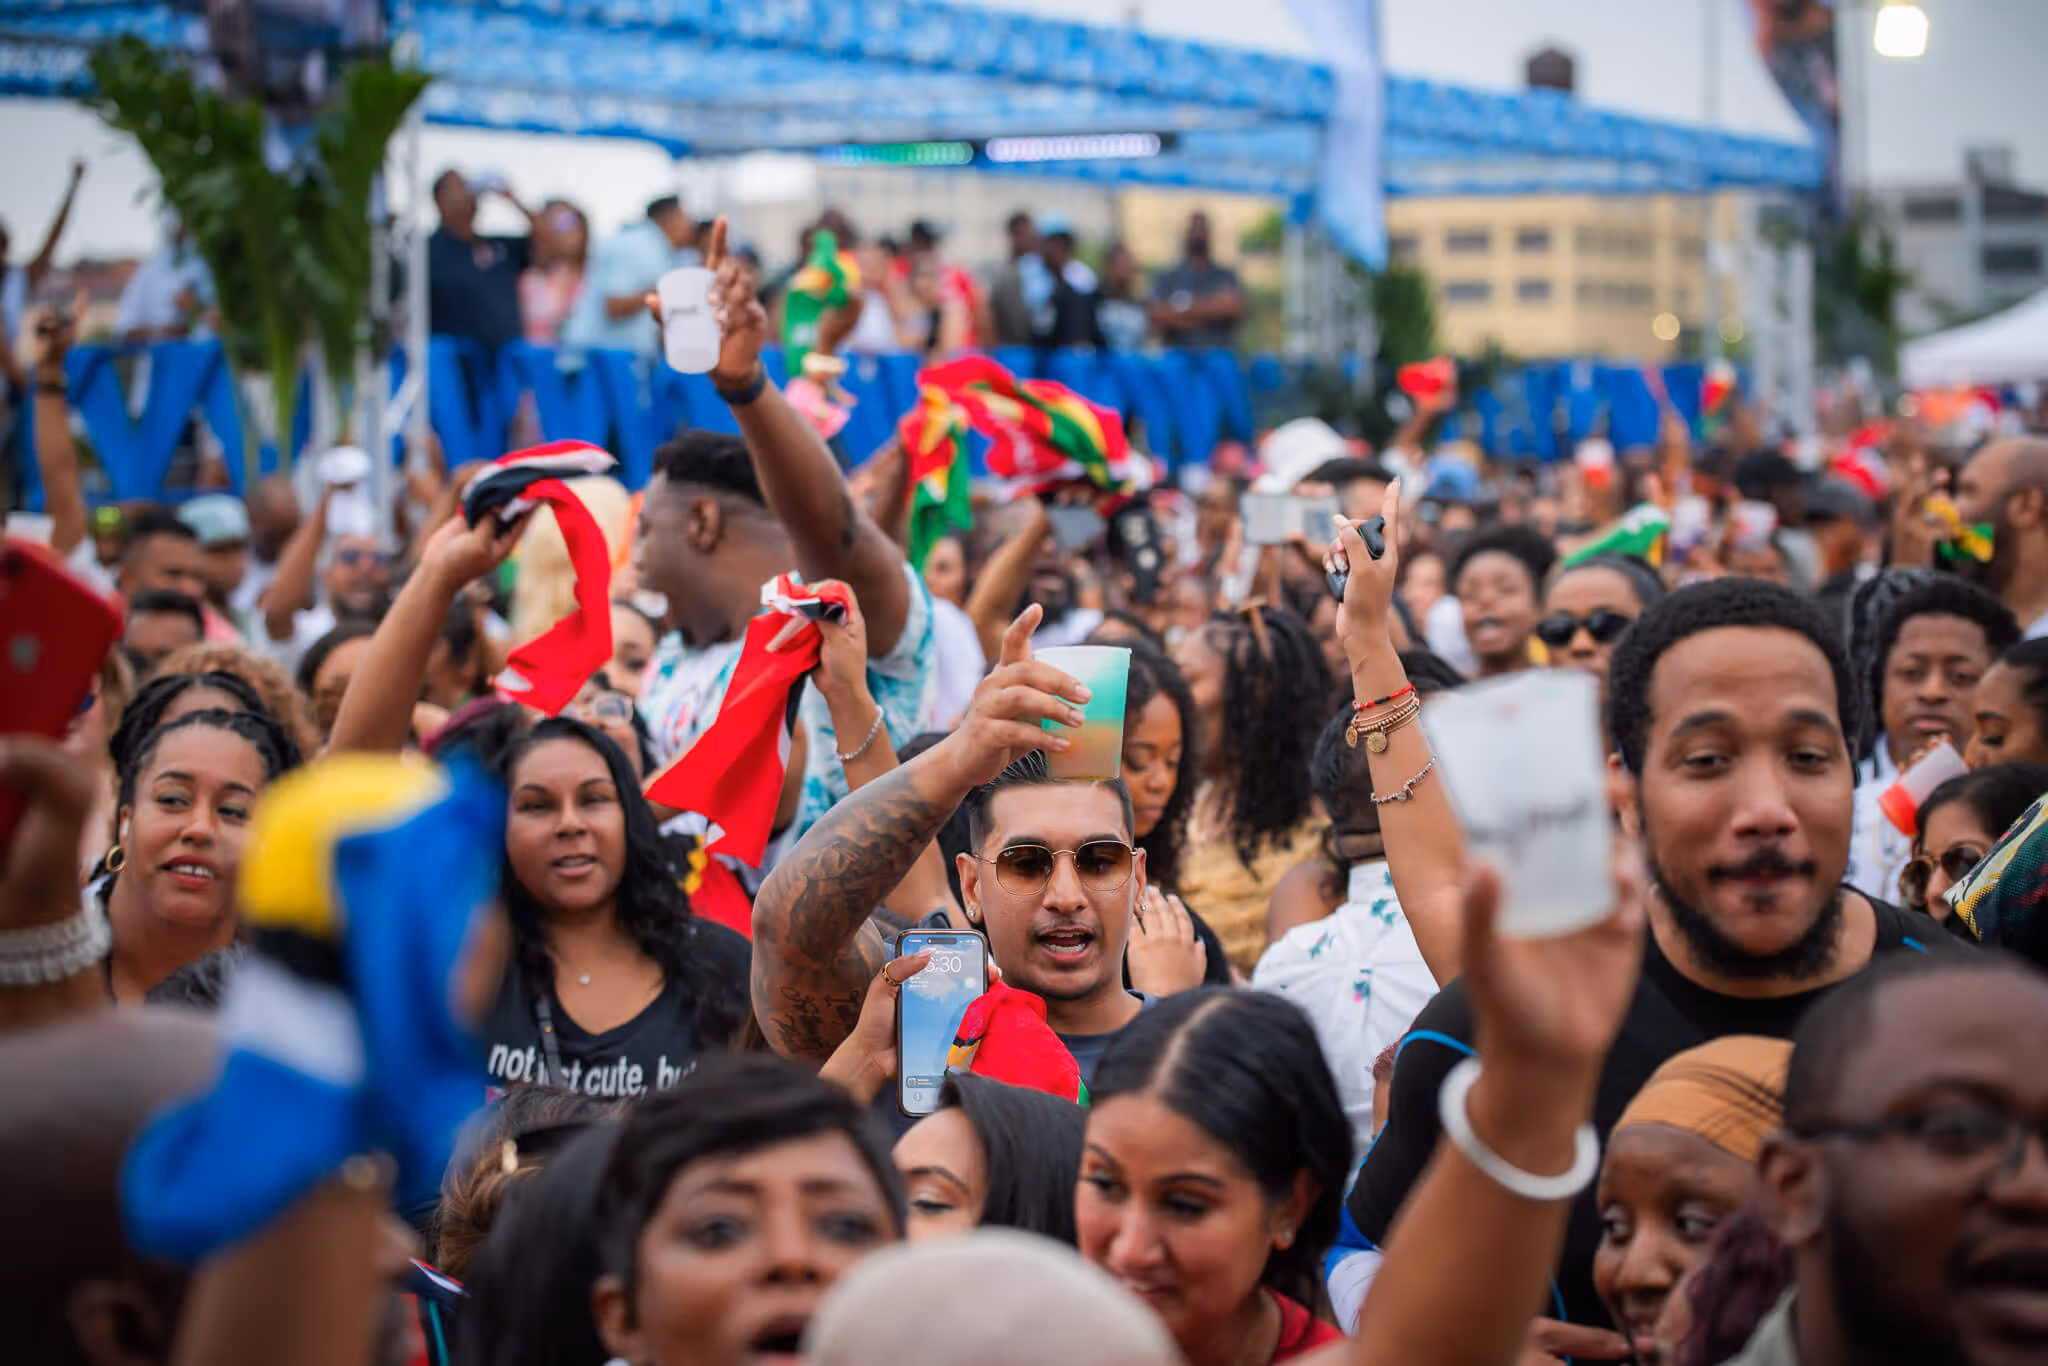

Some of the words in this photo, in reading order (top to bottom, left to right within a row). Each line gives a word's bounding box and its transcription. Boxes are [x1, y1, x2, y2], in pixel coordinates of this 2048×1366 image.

[488, 1043, 536, 1083] not
[537, 1053, 582, 1093] jt
[584, 1055, 648, 1101] cute,
